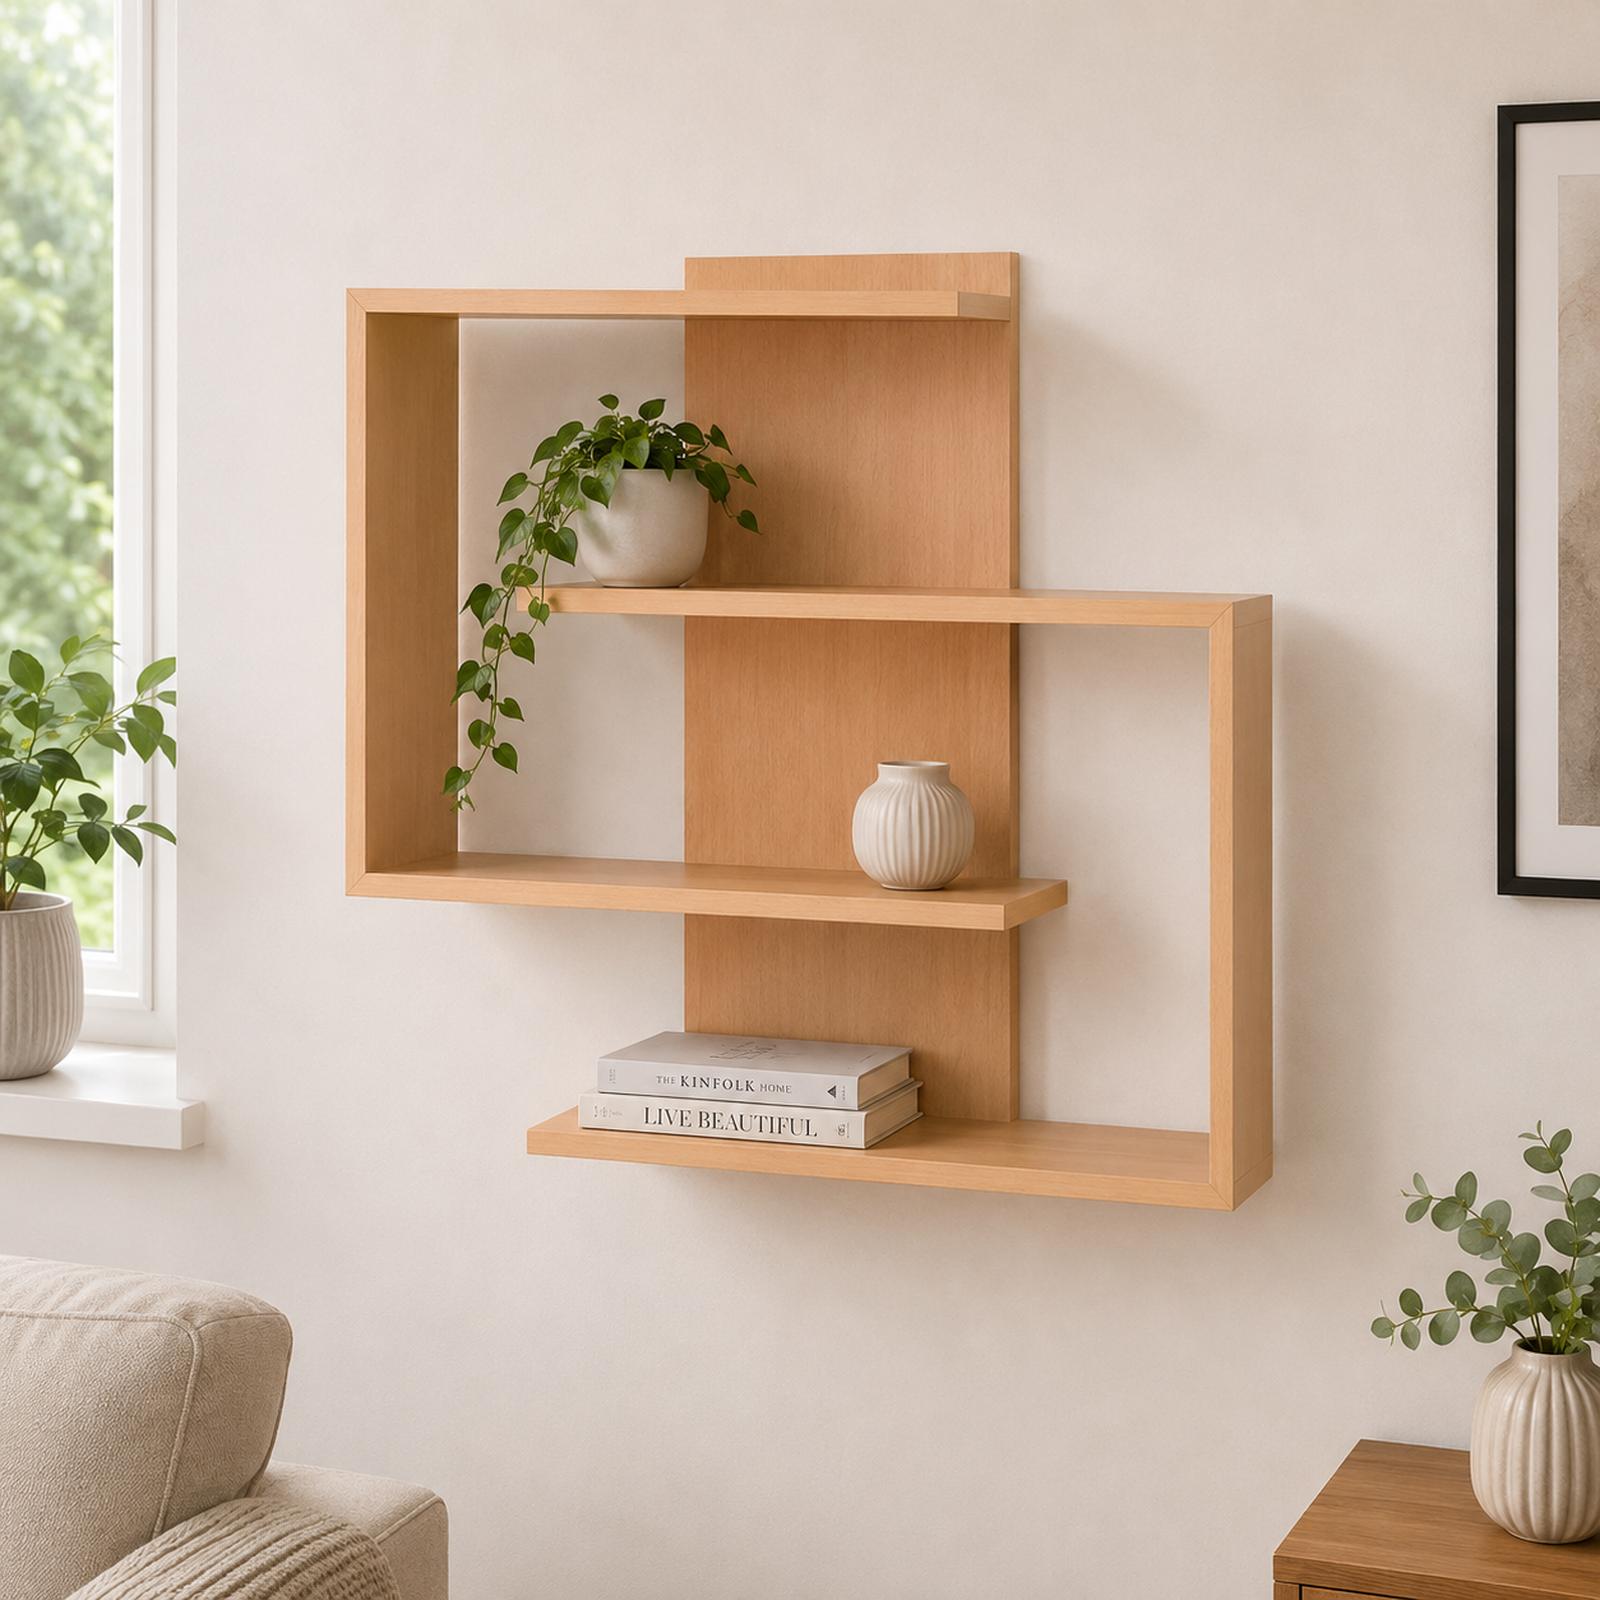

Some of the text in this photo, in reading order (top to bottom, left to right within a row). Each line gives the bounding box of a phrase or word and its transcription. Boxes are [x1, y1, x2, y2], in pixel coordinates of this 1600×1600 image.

[656, 1075, 792, 1094] THE KINFOLK HOME
[644, 1107, 692, 1127] LIVE
[699, 1111, 818, 1137] BEAUTIFUL
